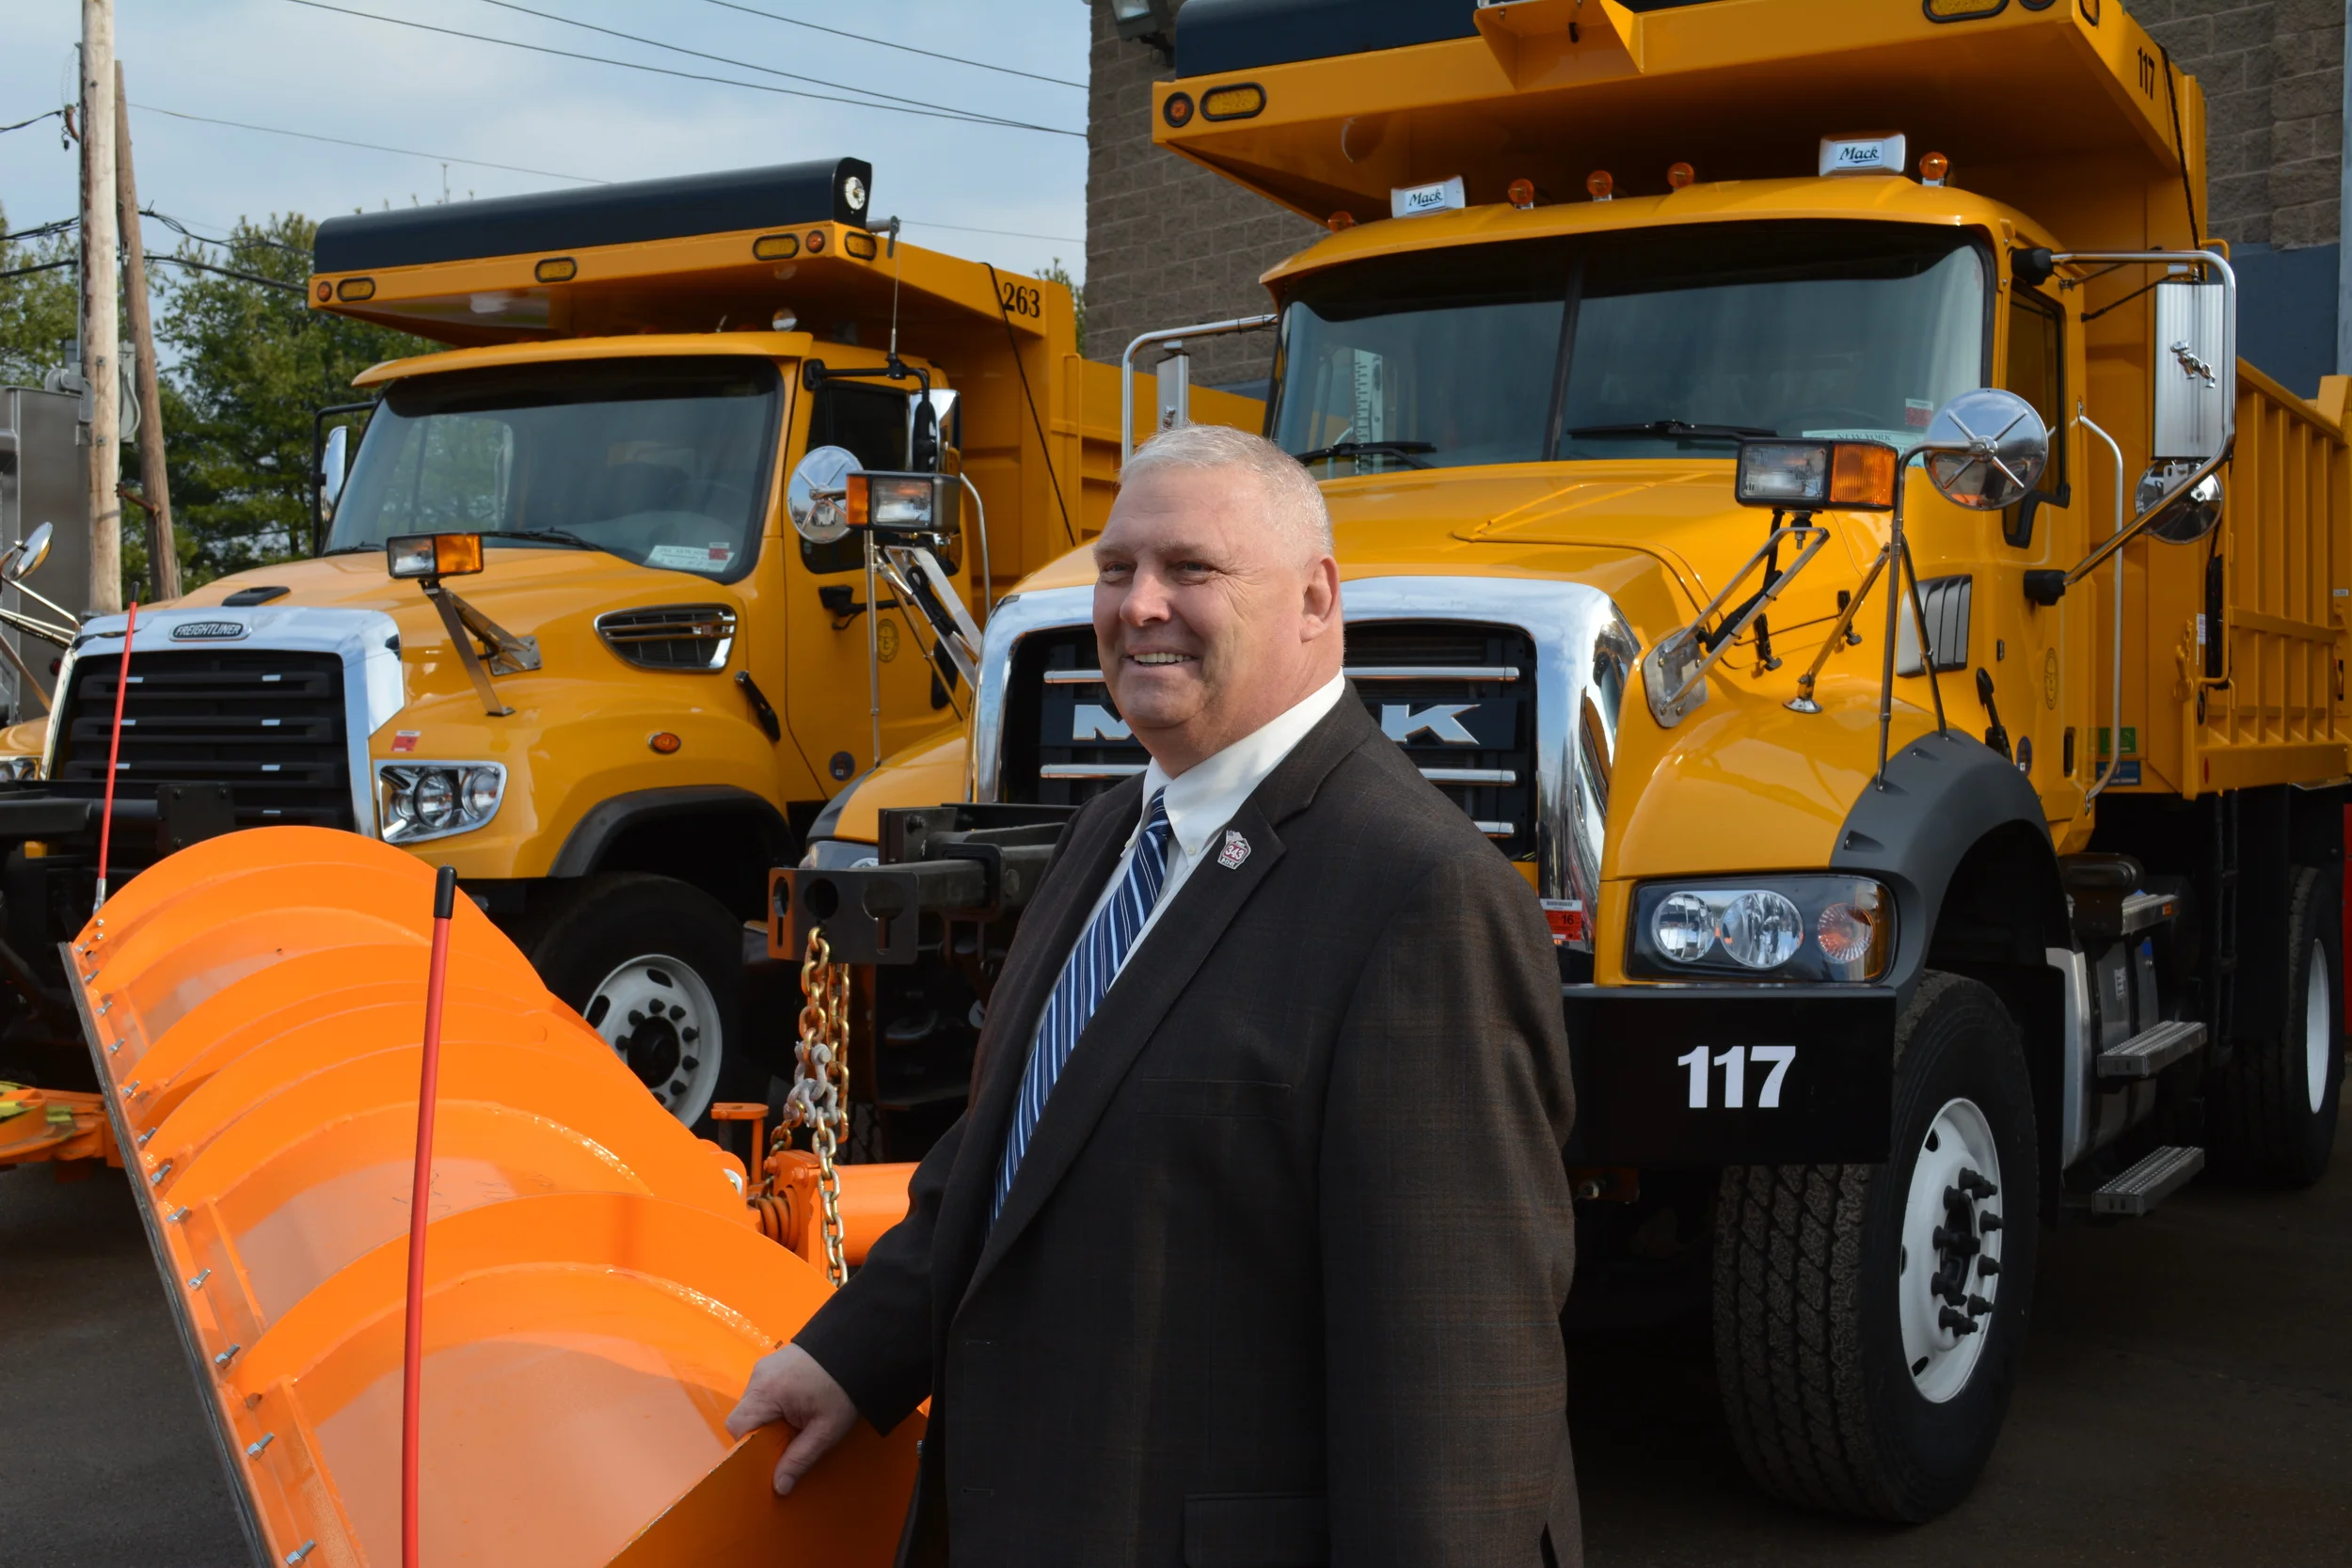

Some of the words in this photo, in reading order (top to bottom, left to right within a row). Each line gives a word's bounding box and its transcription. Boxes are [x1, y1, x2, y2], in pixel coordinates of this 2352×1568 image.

[2137, 46, 2155, 101] 117
[1838, 146, 1880, 163] Mack
[1408, 189, 1442, 207] Mack
[1003, 282, 1041, 318] 263
[174, 624, 242, 637] FREIGHTLINER
[1225, 845, 1245, 861] 343
[1563, 914, 1574, 925] 16
[1677, 1045, 1796, 1108] 117
